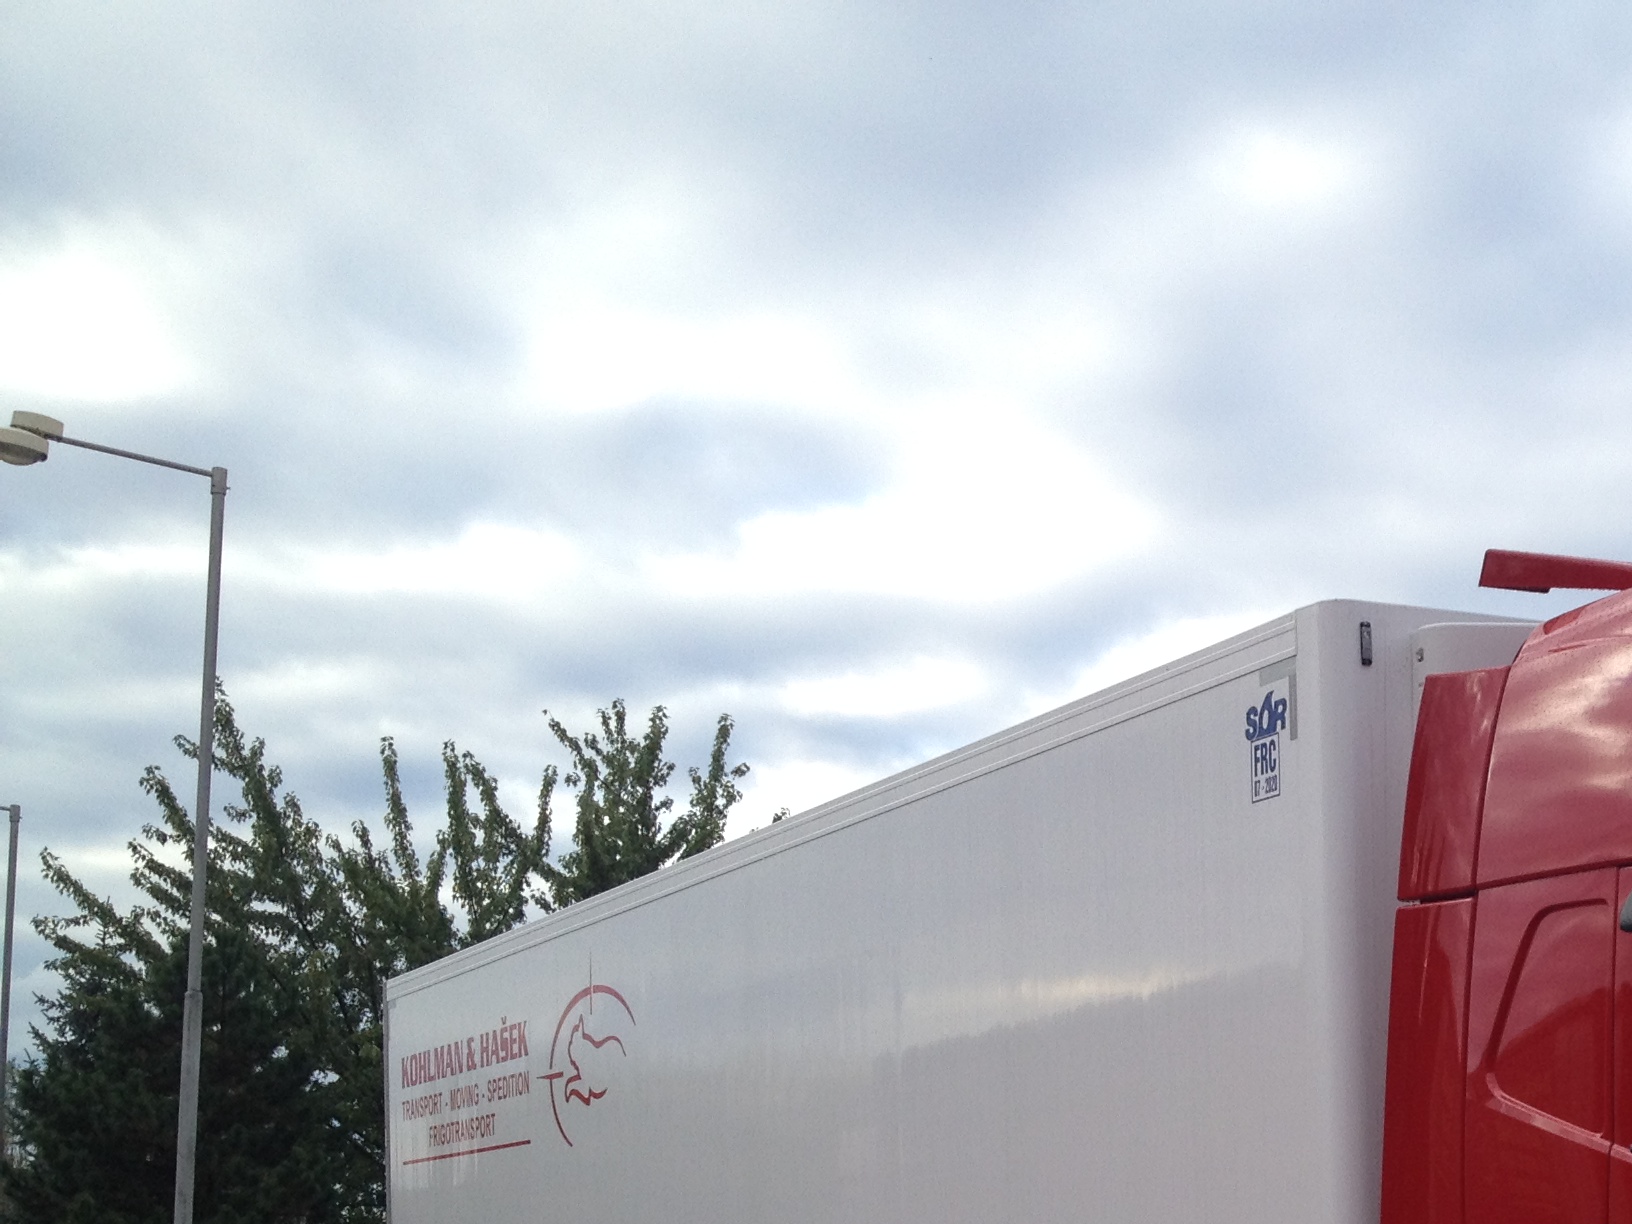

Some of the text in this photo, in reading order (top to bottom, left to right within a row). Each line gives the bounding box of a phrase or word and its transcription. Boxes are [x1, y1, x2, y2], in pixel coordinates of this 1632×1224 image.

[1254, 739, 1277, 777] FRC
[401, 1015, 529, 1089] KOHLMAN & HAŠEK
[402, 1091, 443, 1121] TRANSPORT
[450, 1083, 480, 1111] MOVING
[487, 1070, 530, 1103] SPEDITION
[429, 1112, 496, 1148] FRIGOTRANSPORT
